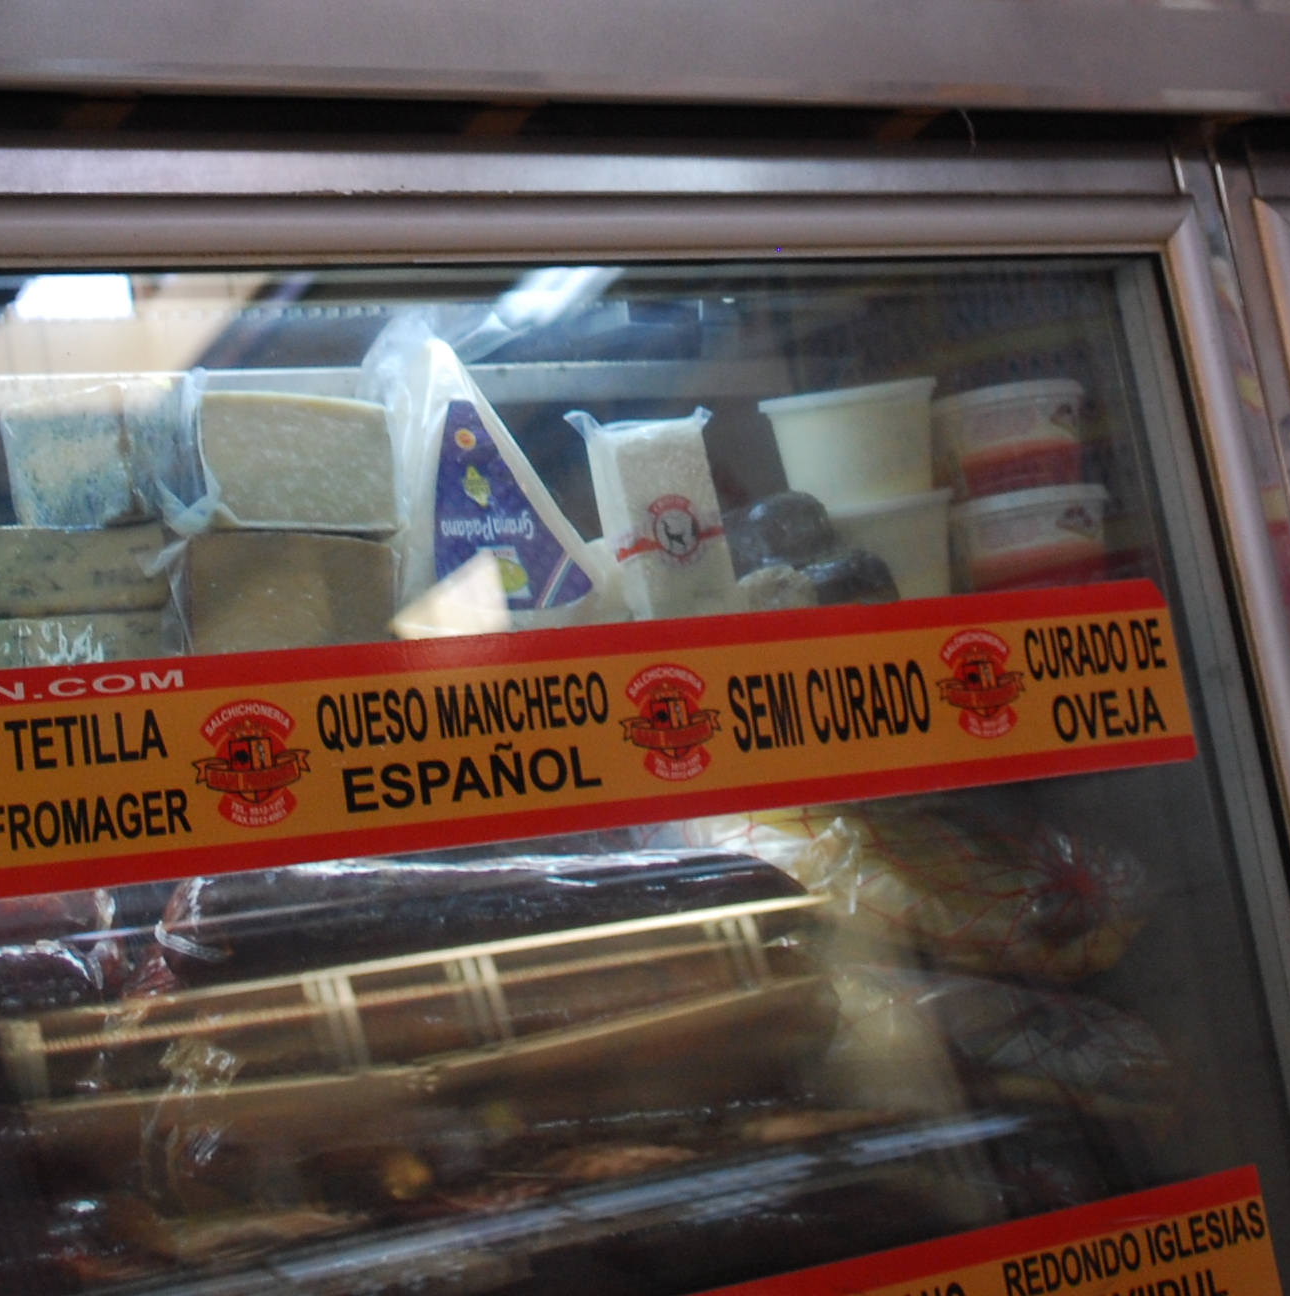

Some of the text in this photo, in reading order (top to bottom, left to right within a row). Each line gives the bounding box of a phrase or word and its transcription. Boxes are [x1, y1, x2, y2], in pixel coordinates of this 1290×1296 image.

[1023, 616, 1168, 683] CURADO DE
[4, 707, 169, 773] TETILLA
[204, 702, 291, 737] SALCHICHONERIA
[316, 670, 609, 755] QUESO MANCHEGO
[727, 659, 932, 754] SEMI CURADO
[1051, 687, 1167, 743] OVEJA
[340, 742, 603, 814] ESPAÑOL
[1003, 1201, 1266, 1296] REDONDO IGLESIAS
